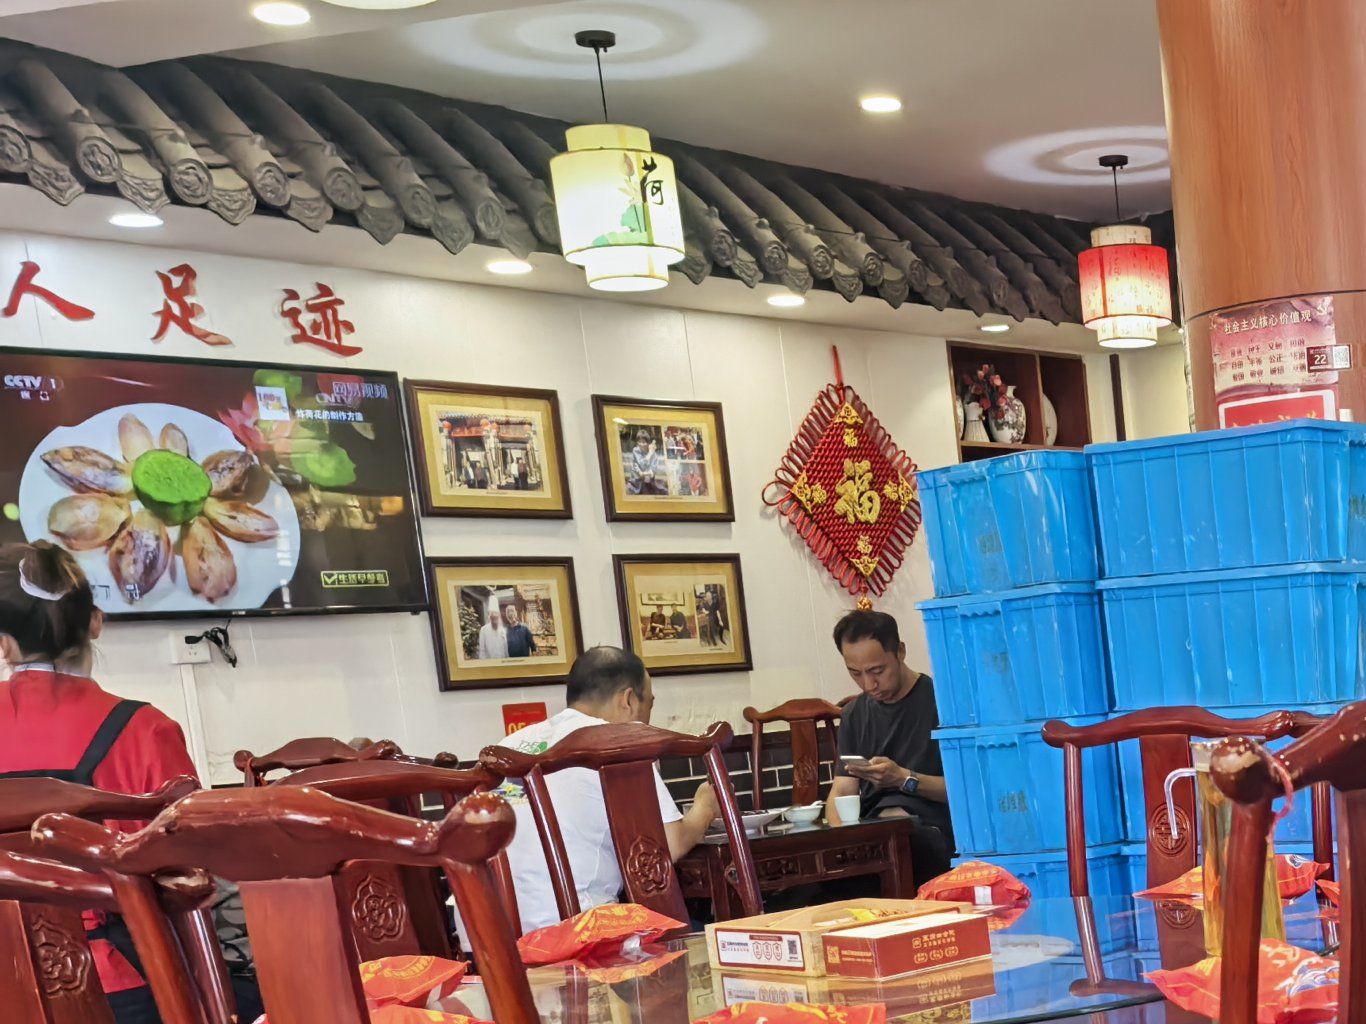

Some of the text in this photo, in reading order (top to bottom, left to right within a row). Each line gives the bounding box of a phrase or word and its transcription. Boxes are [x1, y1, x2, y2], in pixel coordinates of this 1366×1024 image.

[640, 156, 665, 206] 荷
[2, 260, 364, 358] 人足迹
[1224, 310, 1312, 334] 社会主义核心价值观
[1314, 355, 1327, 364] 22
[4, 375, 42, 389] CCTV
[833, 459, 881, 525] 福
